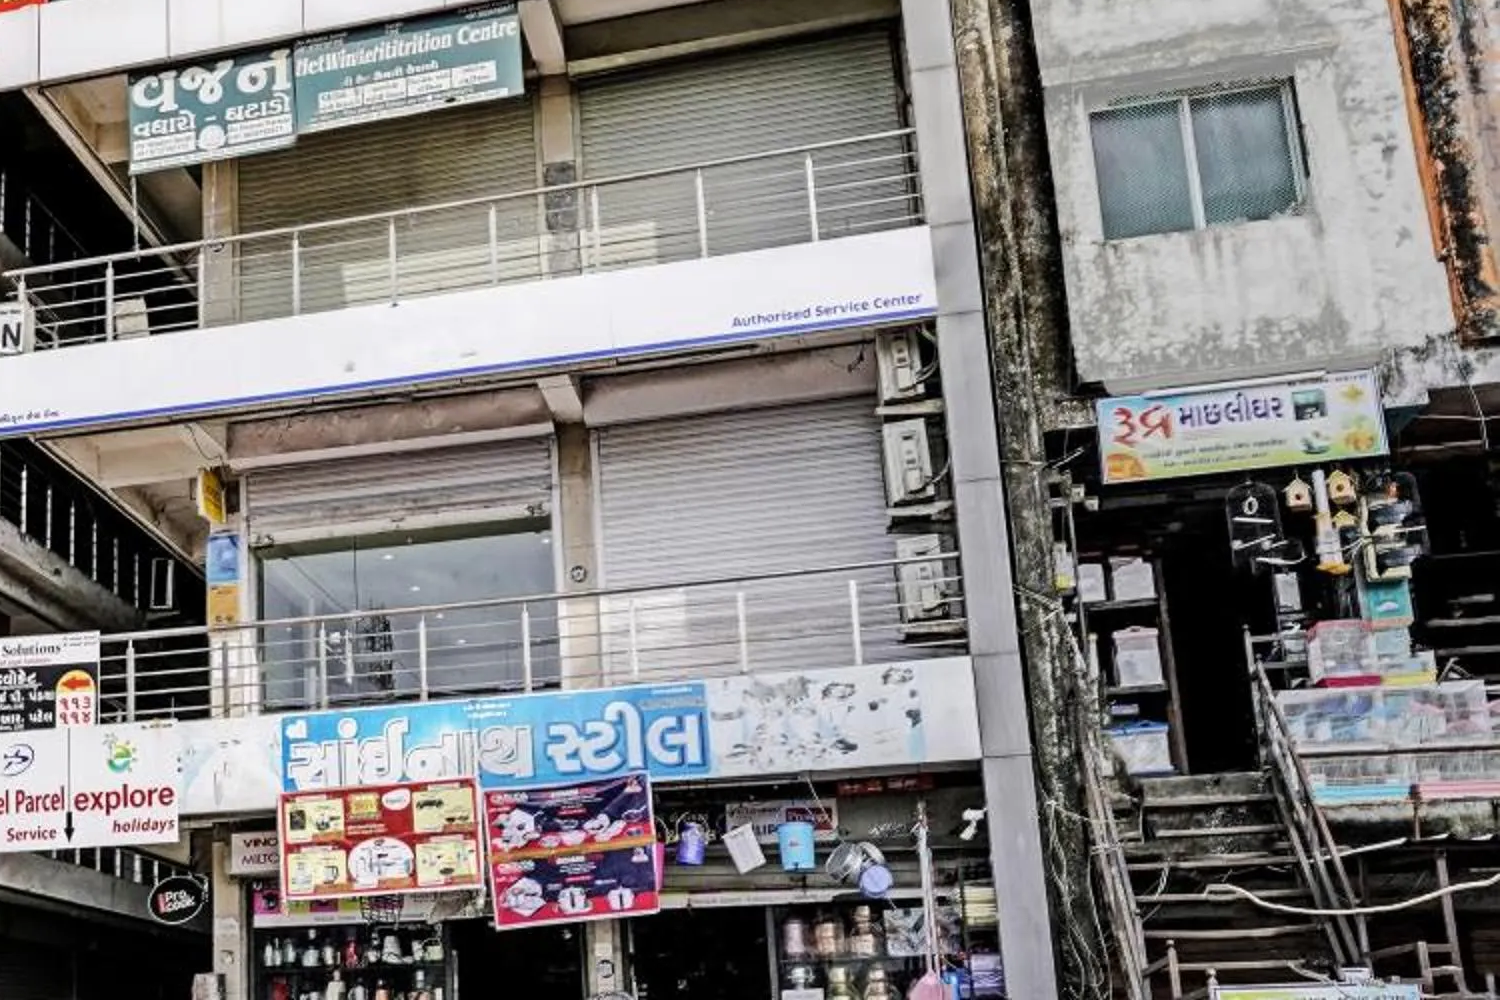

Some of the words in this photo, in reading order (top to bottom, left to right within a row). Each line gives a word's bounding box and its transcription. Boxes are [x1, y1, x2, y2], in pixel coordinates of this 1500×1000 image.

[457, 19, 518, 46] Centre
[731, 307, 811, 329] Authorised
[815, 299, 870, 319] Service
[873, 293, 923, 310] Center
[1178, 392, 1284, 427] માછલીઘર
[1, 643, 62, 658] Solutions
[544, 700, 704, 772] સ્ટીલ
[15, 785, 65, 813] Parcel
[74, 784, 175, 816] explore
[6, 826, 57, 843] Service
[112, 818, 176, 834] holidays
[243, 838, 278, 848] VINO
[242, 852, 279, 865] MILTO
